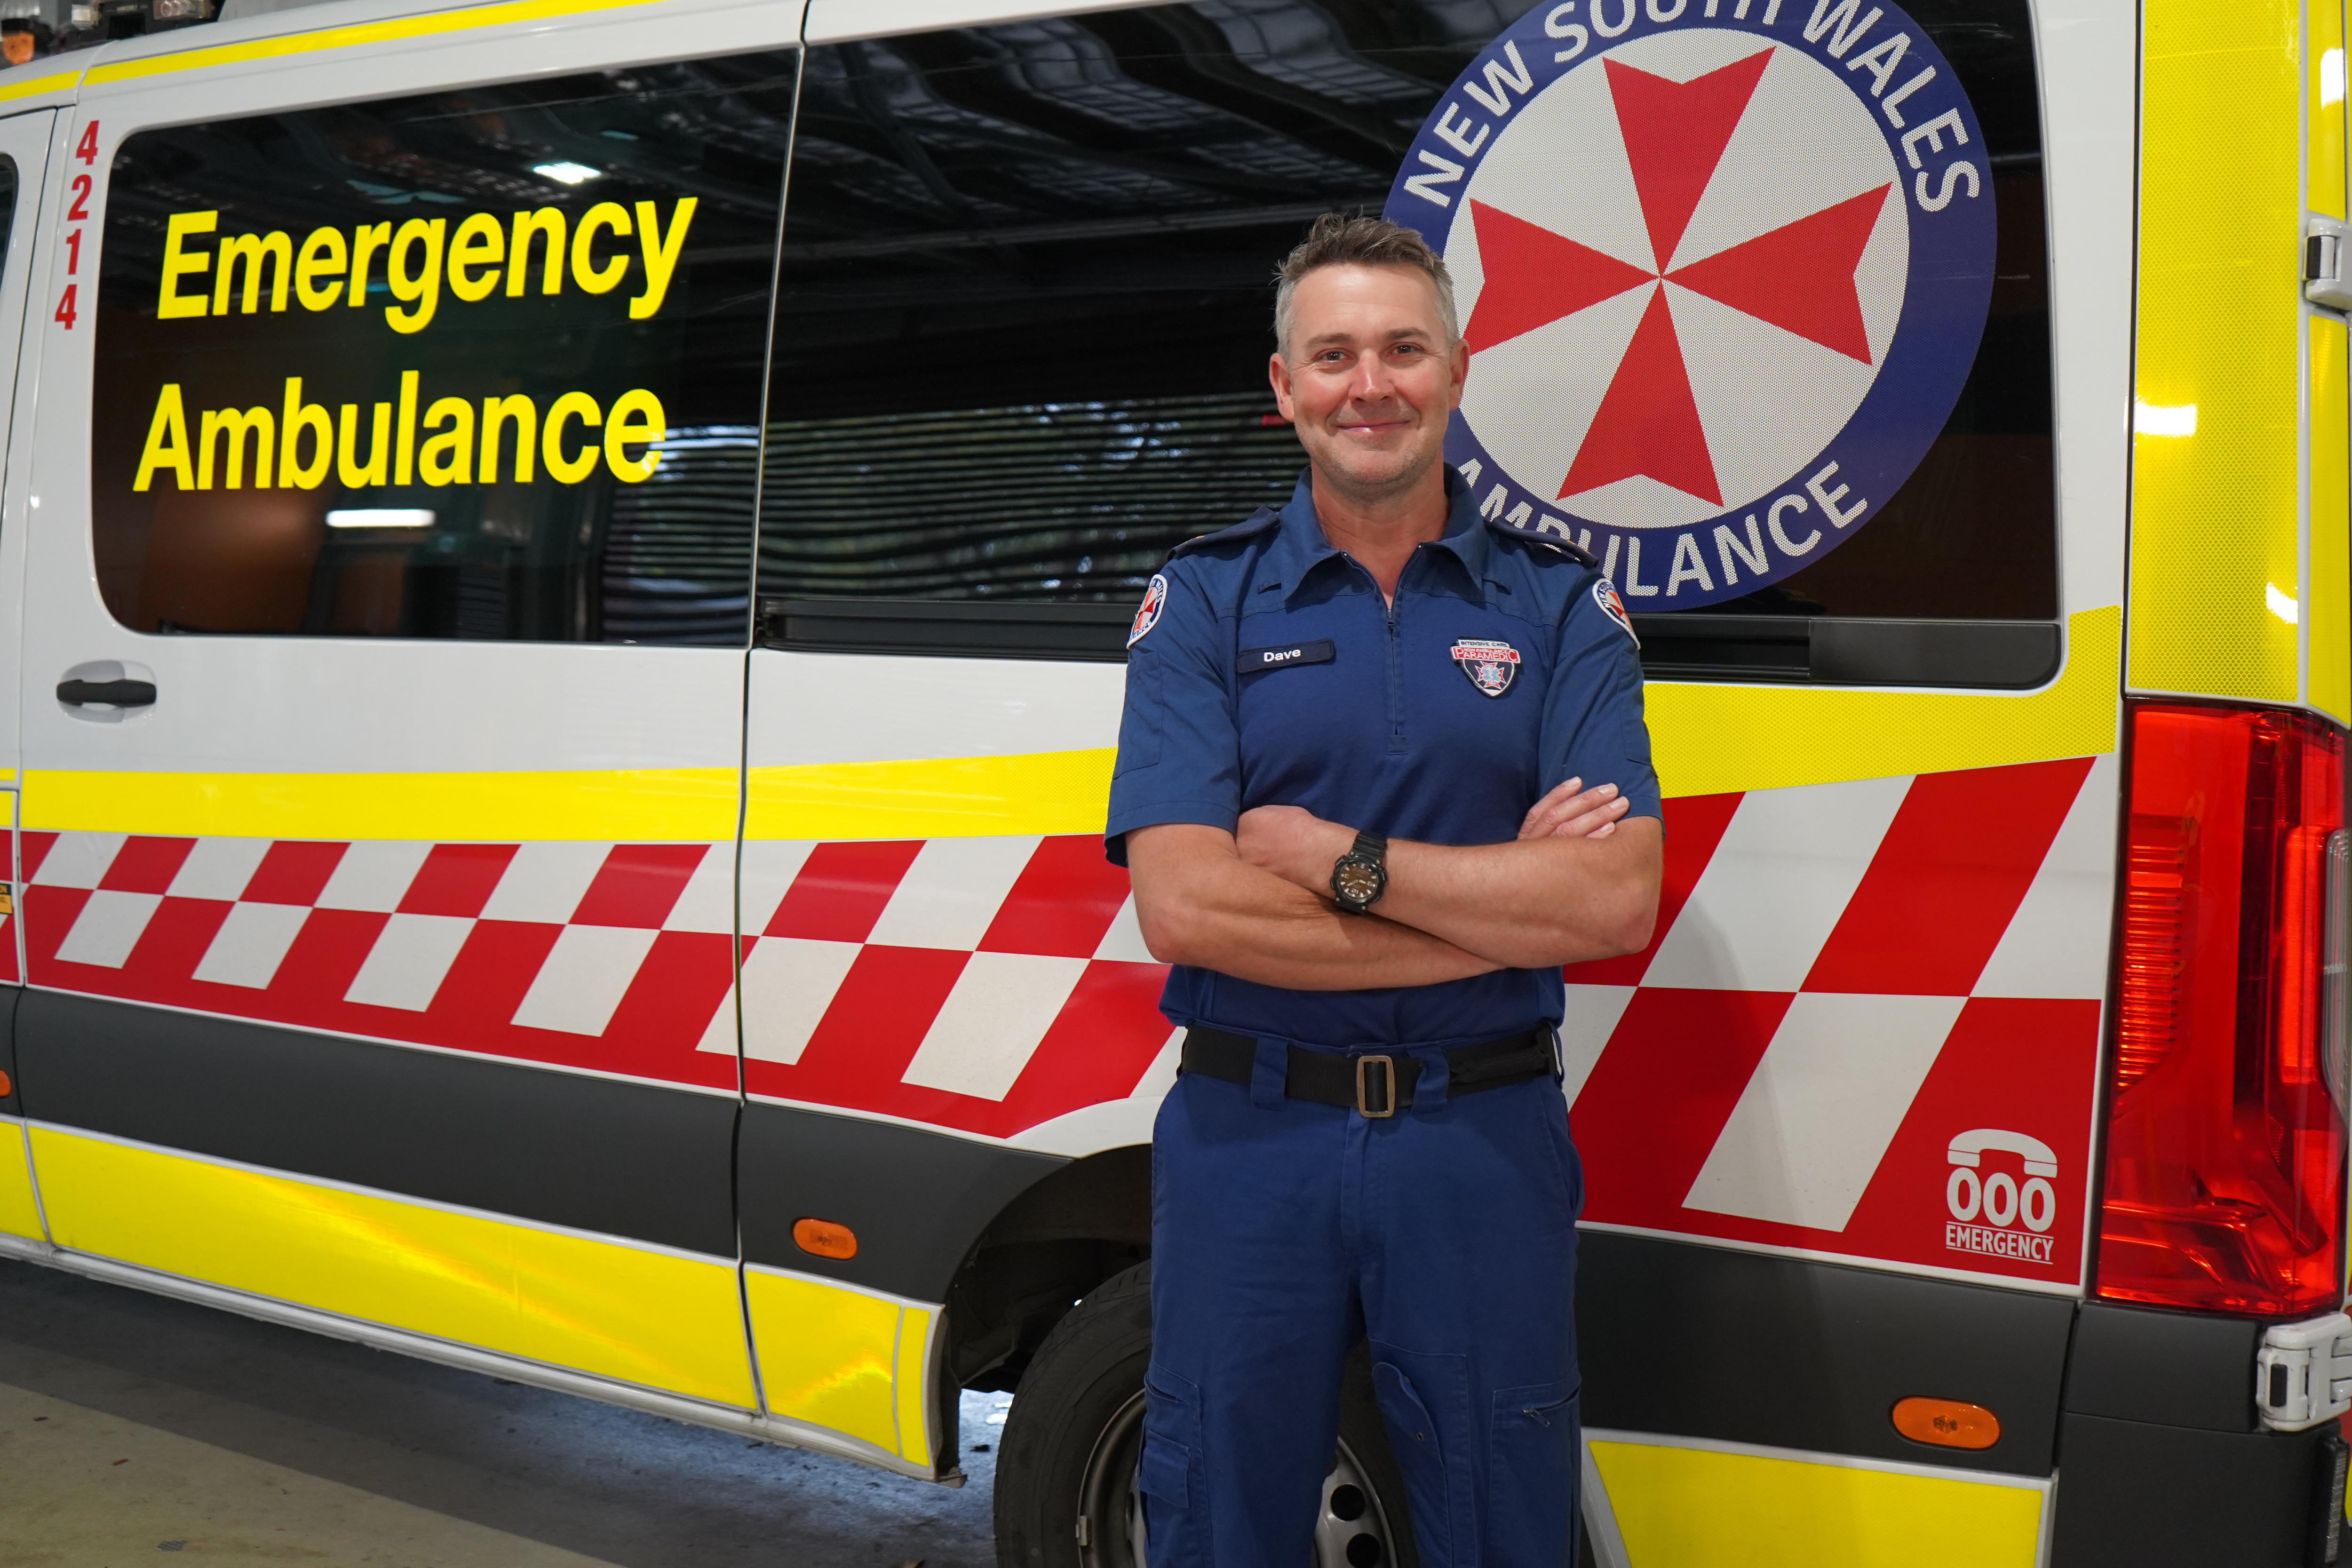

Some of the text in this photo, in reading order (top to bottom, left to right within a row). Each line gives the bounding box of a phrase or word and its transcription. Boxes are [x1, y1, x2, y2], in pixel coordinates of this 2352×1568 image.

[1404, 40, 1534, 208] NEW
[1803, 0, 1979, 212] WALES
[55, 120, 100, 329] 4214
[157, 197, 698, 334] Emergency
[132, 370, 666, 492] Ambulance
[1263, 649, 1301, 662] Dave
[1455, 647, 1518, 661] PARAMEDIC
[1946, 1167, 2056, 1233] 000
[1946, 1224, 2054, 1261] EMERGENCY
